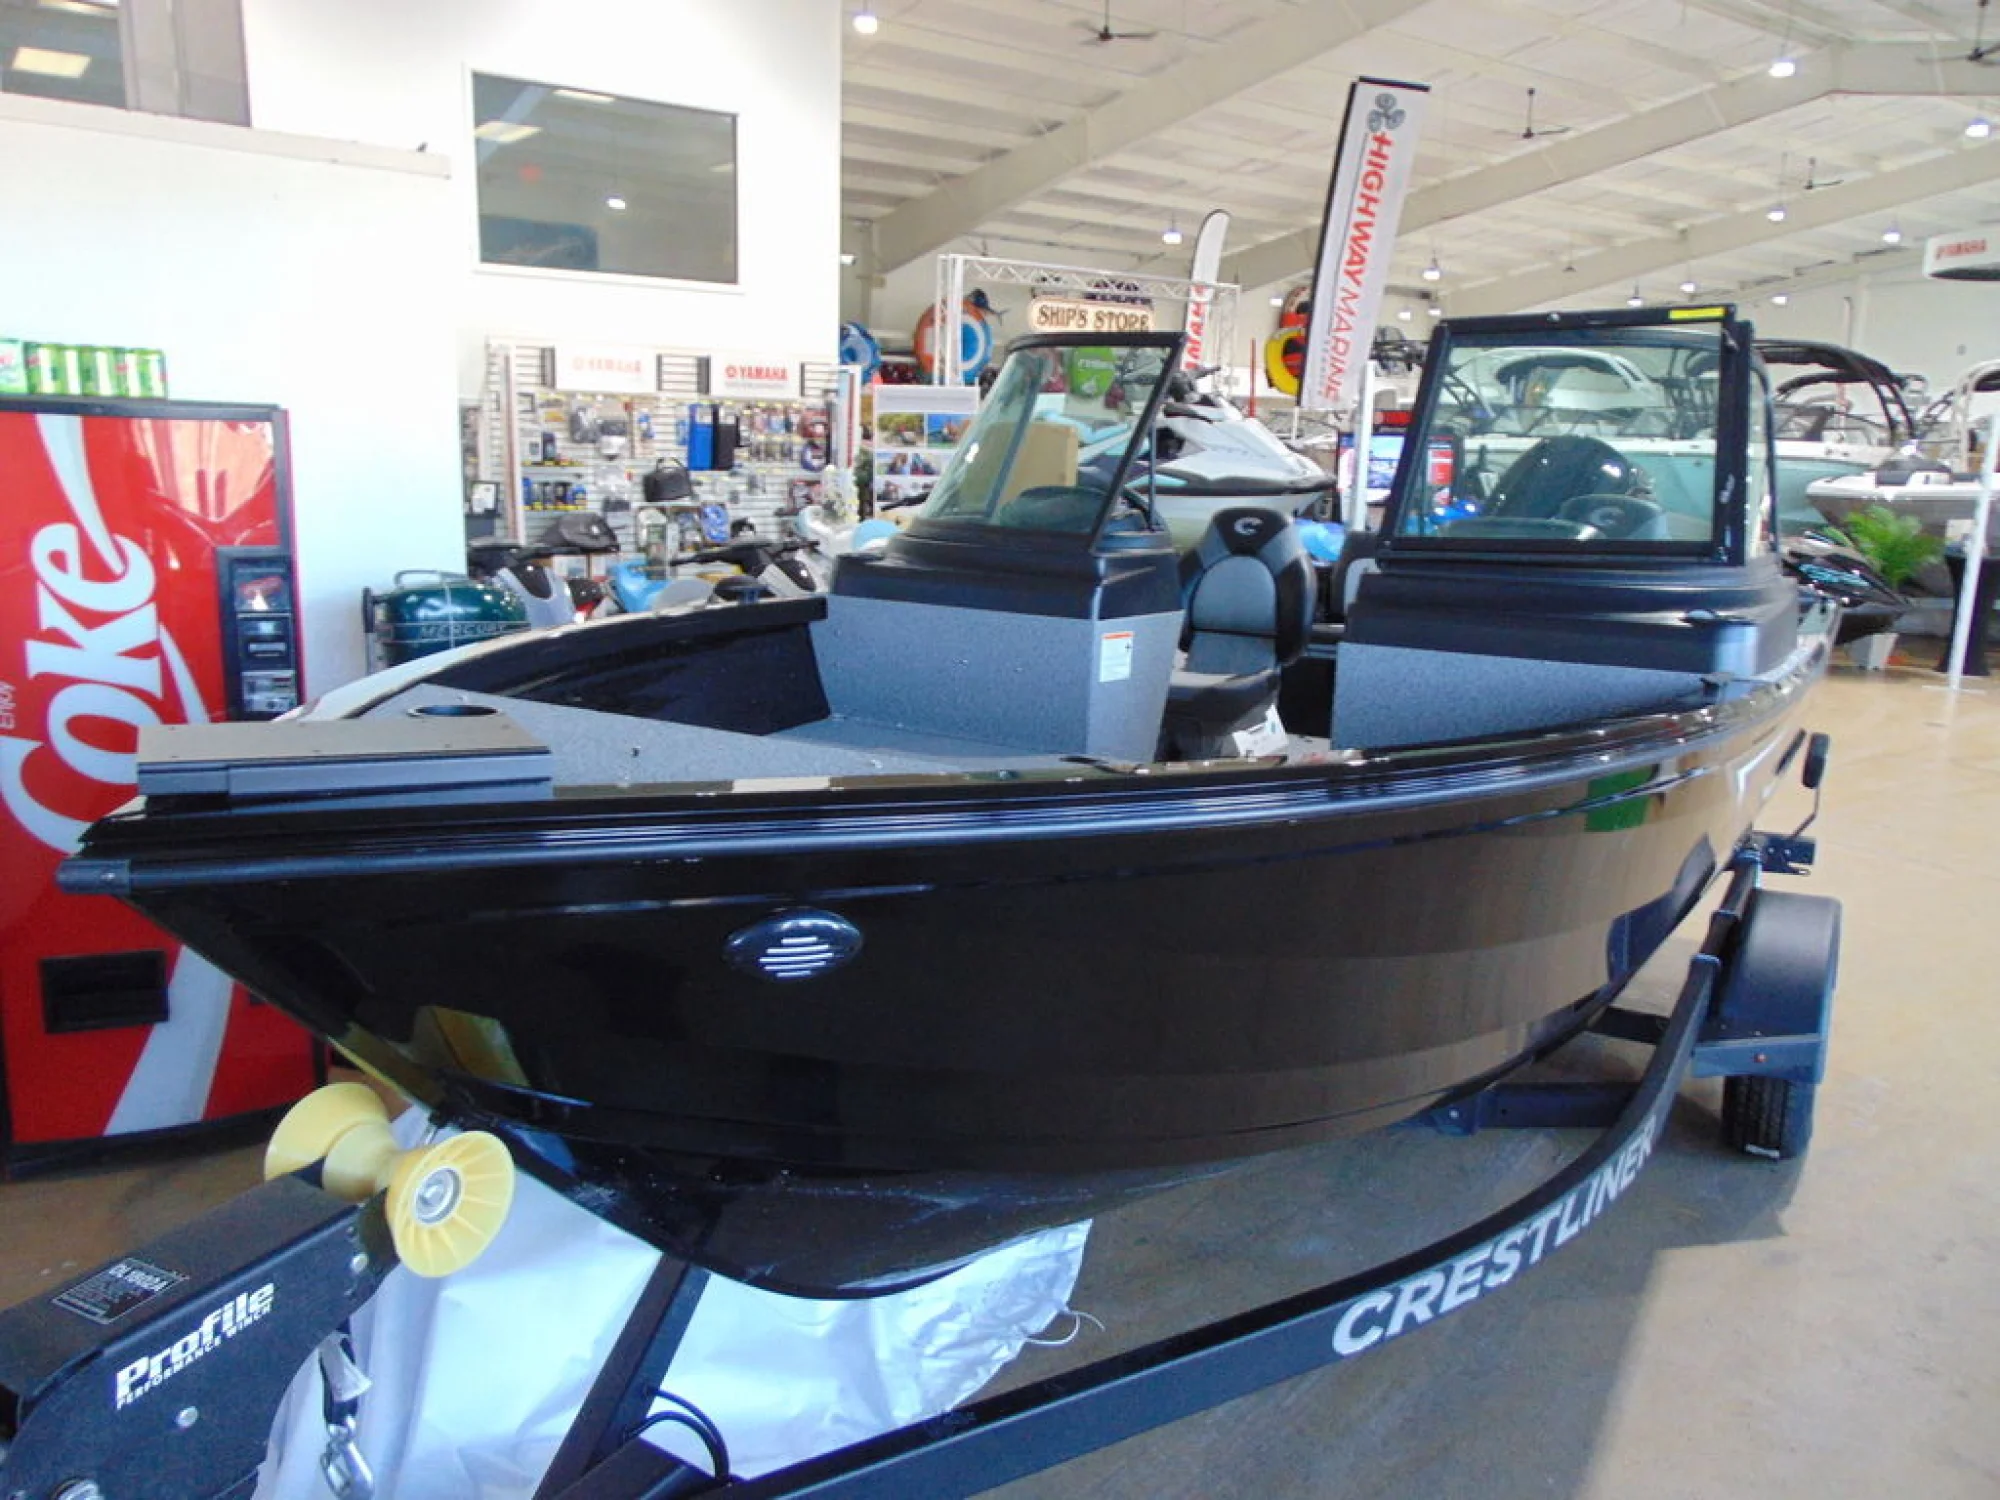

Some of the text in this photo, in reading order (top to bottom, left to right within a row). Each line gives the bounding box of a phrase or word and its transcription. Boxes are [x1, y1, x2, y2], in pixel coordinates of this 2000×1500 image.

[1325, 131, 1393, 402] HIGHWAY MARINE
[1093, 310, 1150, 335] STORE
[587, 357, 642, 374] YAMAHA
[738, 365, 788, 382] YAMAHA
[0, 522, 163, 857] Coke
[0, 681, 16, 730] Enjoy
[1332, 1116, 1656, 1357] CRESTLINER
[116, 1283, 275, 1398] Profile
[116, 1336, 222, 1411] PERFORMANCE
